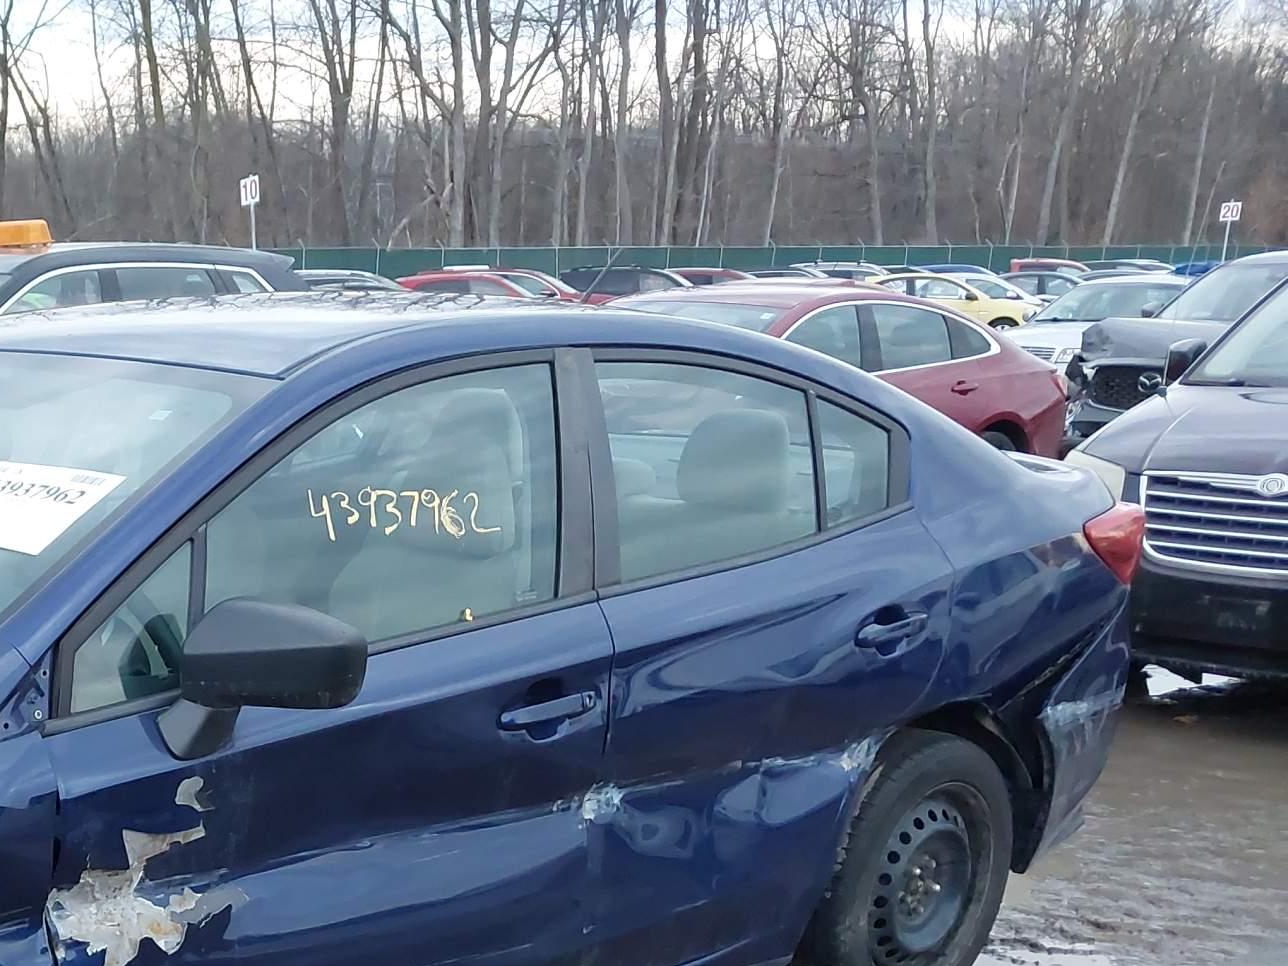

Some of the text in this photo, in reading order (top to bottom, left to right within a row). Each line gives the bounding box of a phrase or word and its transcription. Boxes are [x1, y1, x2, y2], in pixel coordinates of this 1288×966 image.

[242, 178, 258, 202] 10
[1221, 203, 1240, 219] 20
[306, 485, 502, 542] 43937962
